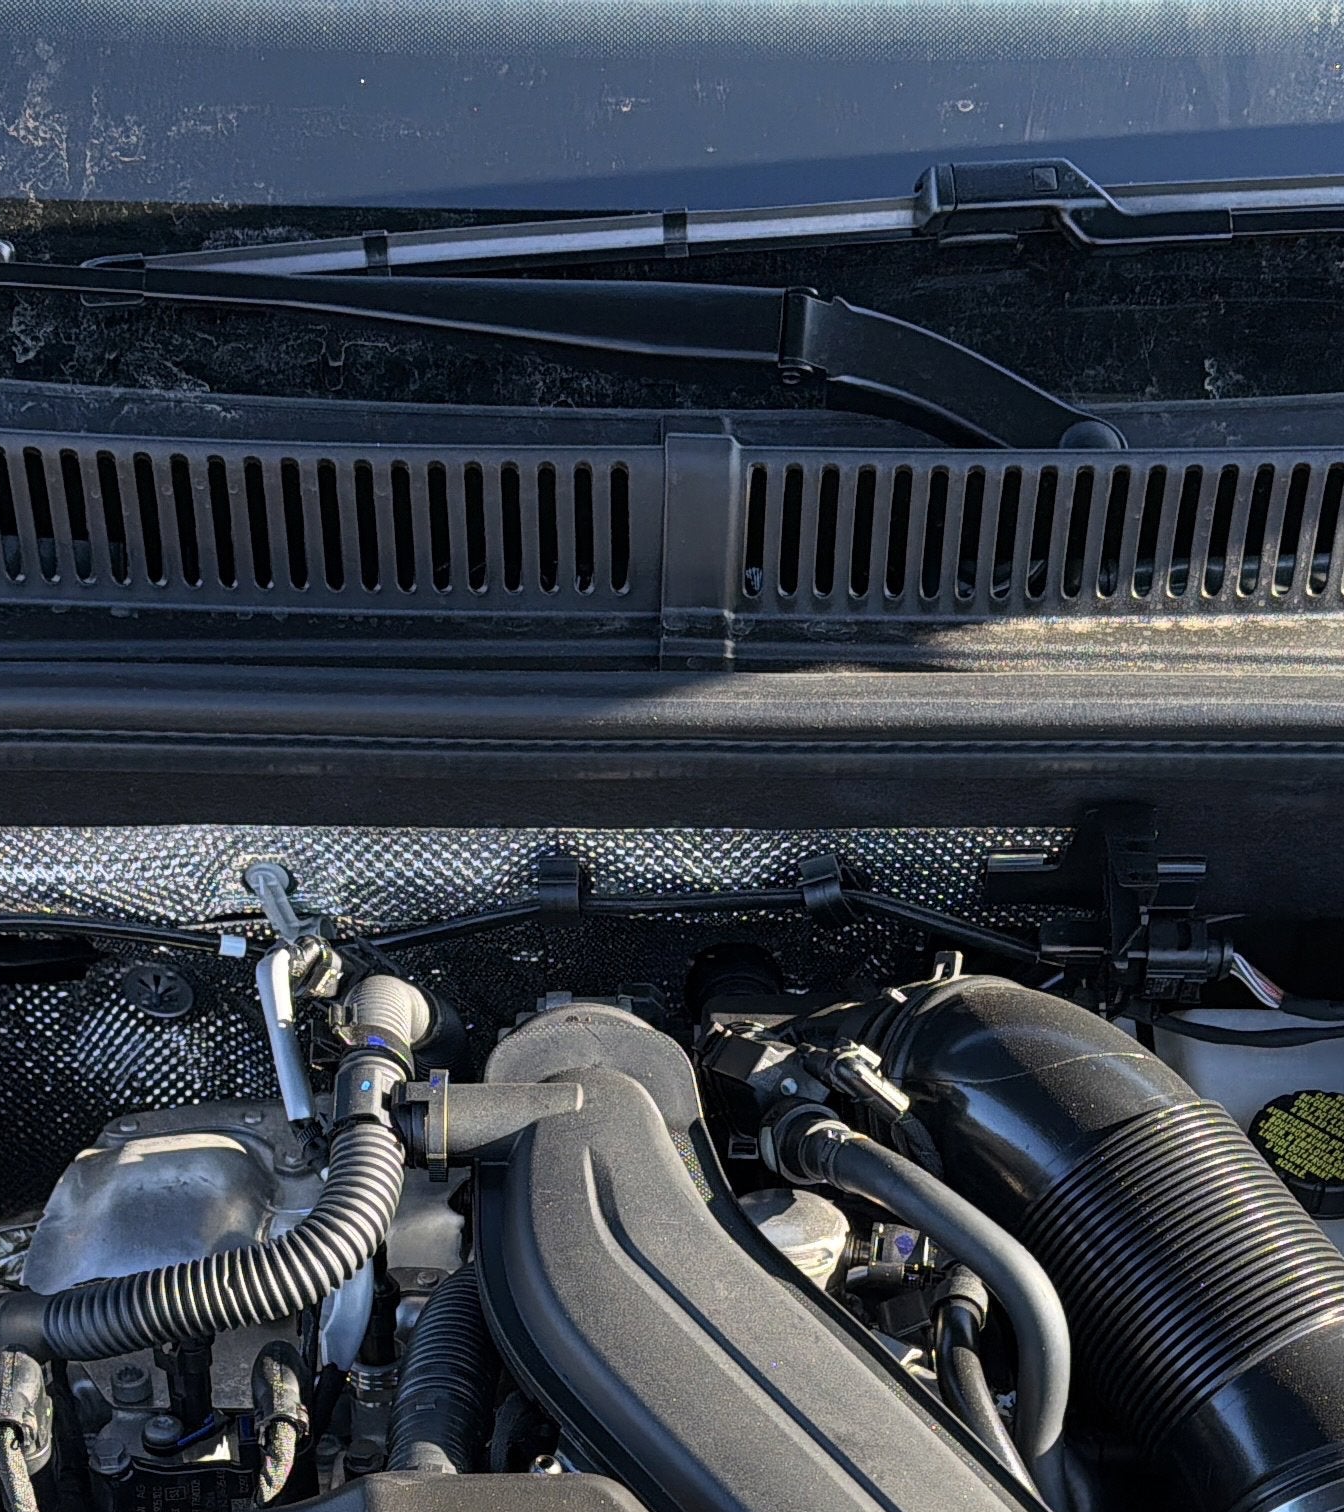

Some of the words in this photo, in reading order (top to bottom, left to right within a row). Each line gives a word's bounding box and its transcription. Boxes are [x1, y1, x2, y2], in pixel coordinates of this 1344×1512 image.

[1293, 1098, 1314, 1113] ONLY
[1298, 1091, 1330, 1112] BEFORE
[1314, 1091, 1340, 1109] CLEAN
[1296, 1108, 1327, 1129] SEALED
[1258, 1128, 1290, 1148] LIQUIDE
[1267, 1114, 1308, 1139] BOUCHON
[1304, 1134, 1332, 1153] AVANT
[1332, 1148, 1344, 1159] DE
[1283, 1150, 1333, 1181] CONTENANT
